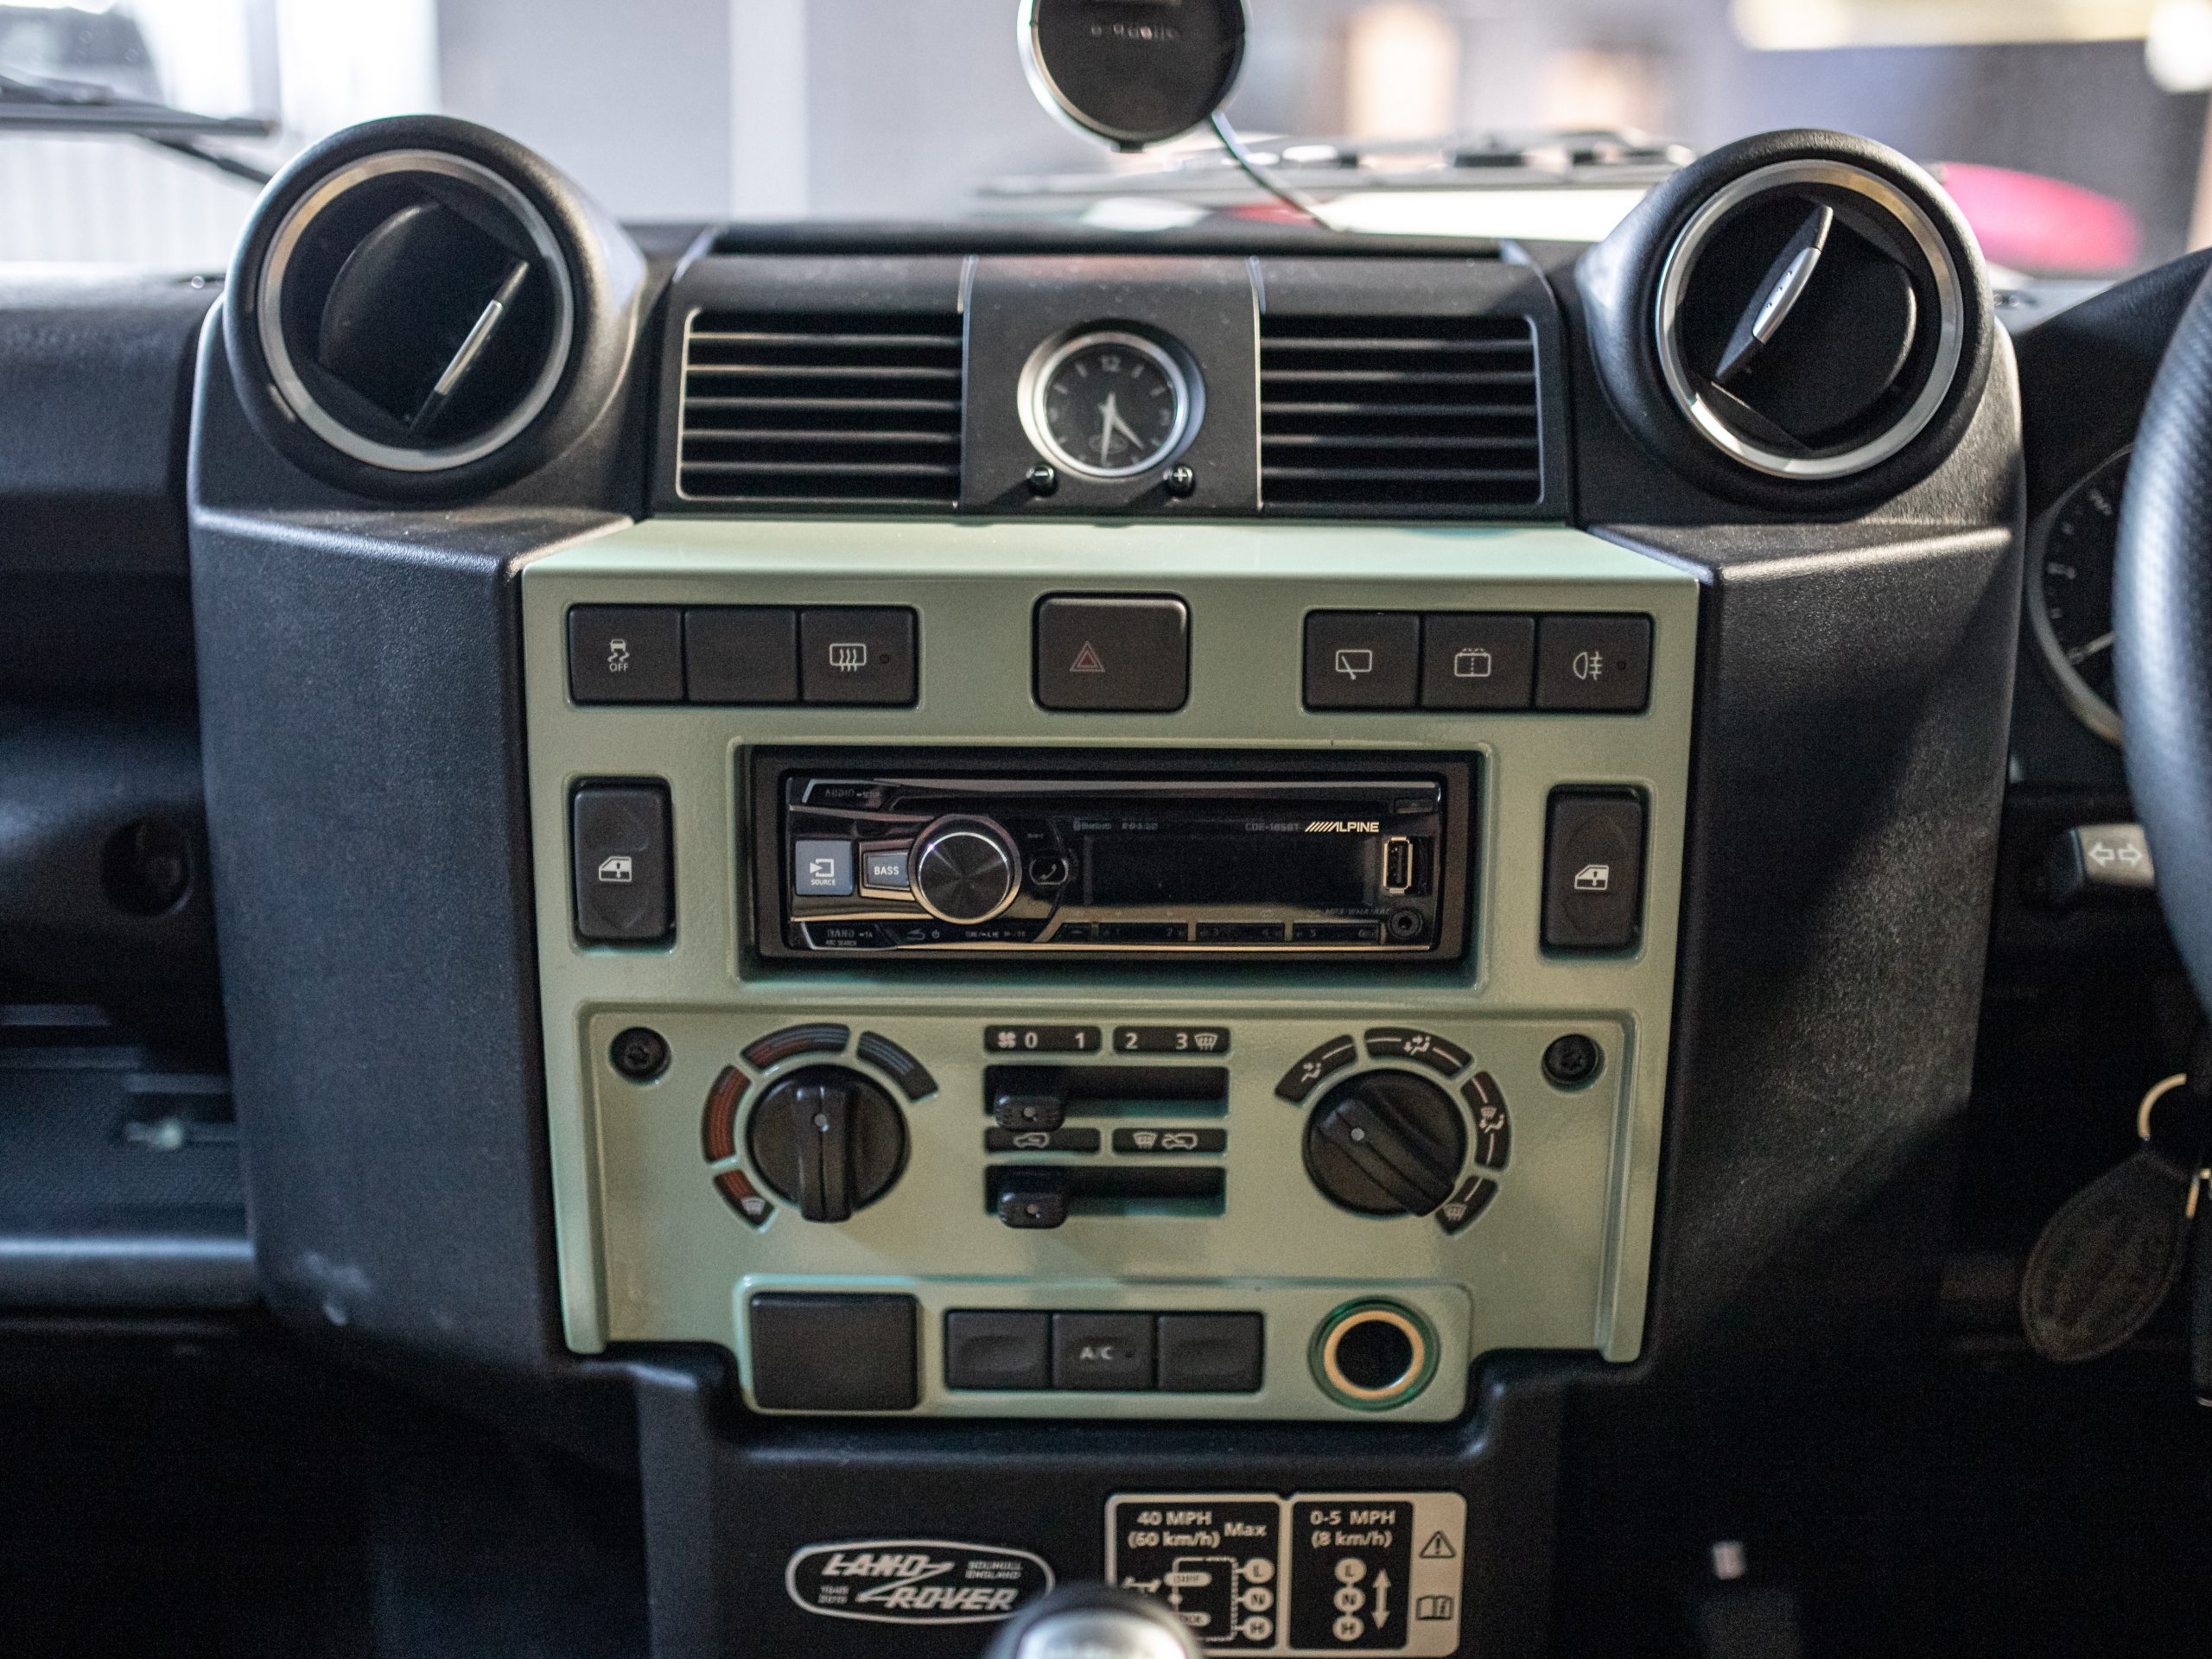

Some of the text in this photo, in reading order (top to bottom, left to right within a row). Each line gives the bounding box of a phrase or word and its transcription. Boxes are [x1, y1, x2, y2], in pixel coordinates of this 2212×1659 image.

[609, 663, 629, 672] OFF
[1331, 822, 1380, 833] ALPINE
[874, 866, 899, 876] BASS
[1024, 1032, 1084, 1048] 0 1
[1126, 1033, 1188, 1049] 2 3
[1137, 1510, 1212, 1526] 40 MPH
[1310, 1510, 1396, 1526] 0-5 MPH
[1224, 1522, 1267, 1539] Max
[1163, 1530, 1221, 1548] km/h)
[1312, 1529, 1393, 1548] (8 km/h)
[822, 1554, 930, 1577] LAND
[1254, 1565, 1264, 1578] L
[1344, 1565, 1356, 1578] L
[884, 1587, 1019, 1611] ROVER
[1251, 1593, 1265, 1605] N
[1342, 1593, 1356, 1605] N
[1251, 1622, 1264, 1634] H
[1342, 1622, 1355, 1634] H
